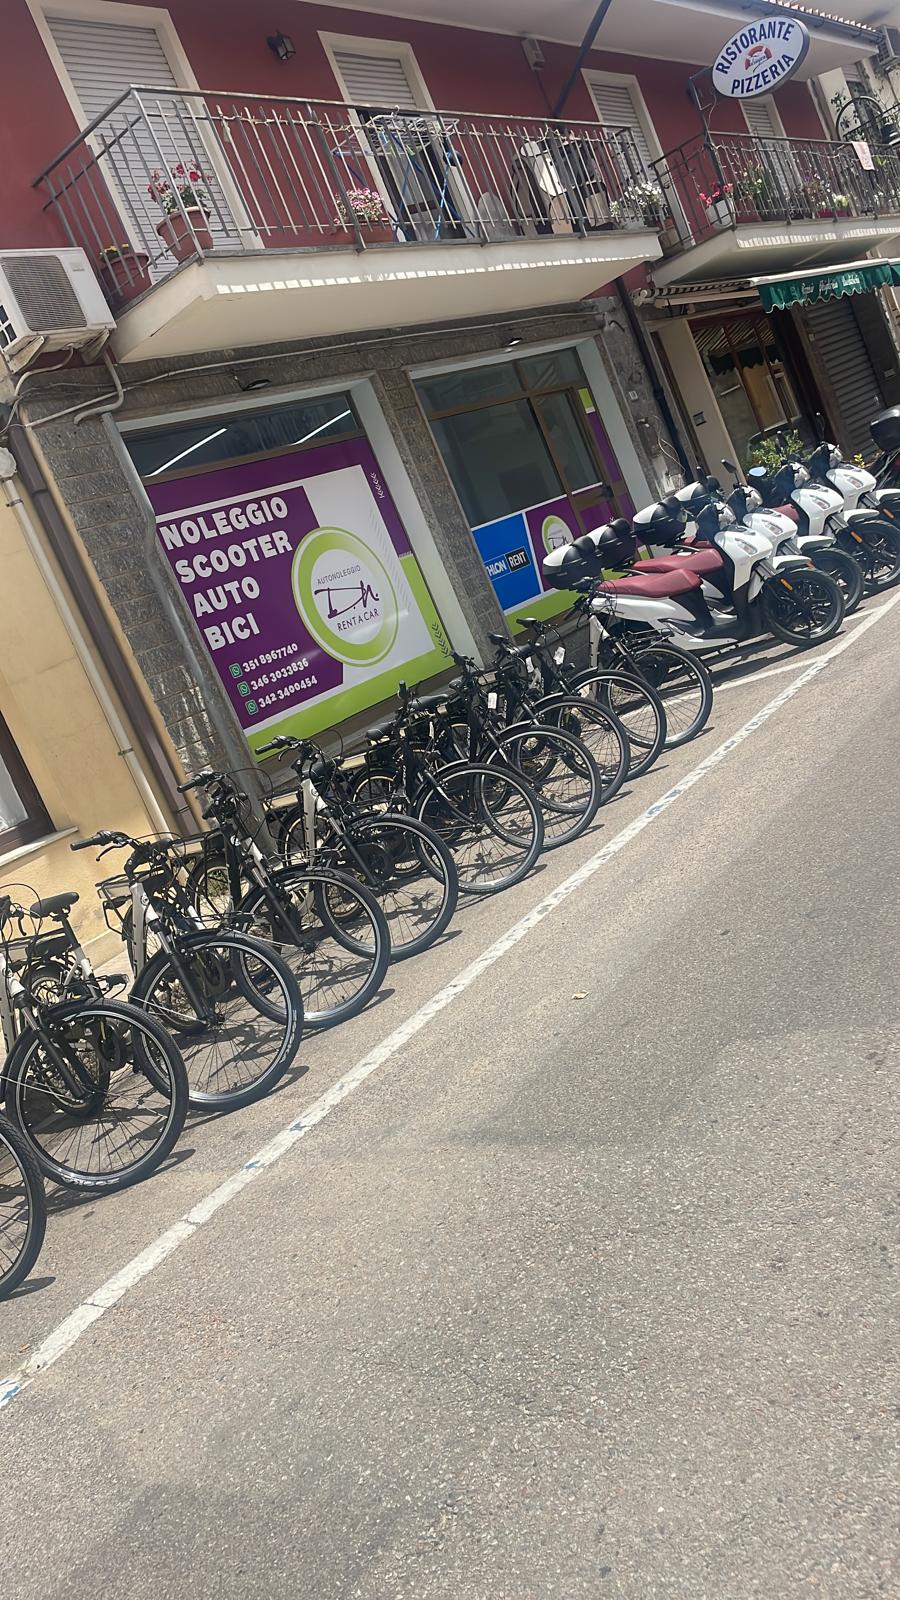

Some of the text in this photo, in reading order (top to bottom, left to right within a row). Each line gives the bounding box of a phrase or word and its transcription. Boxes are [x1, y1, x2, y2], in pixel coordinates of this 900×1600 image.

[715, 21, 795, 75] RISTORANTE
[731, 54, 795, 95] PIZZERIA
[159, 497, 288, 550] NOLEGGIO
[175, 530, 293, 583] SCOOTER
[317, 564, 361, 585] AUTONOLEGGIO
[508, 551, 526, 568] RENT
[193, 576, 260, 617] AUTO
[204, 612, 260, 651] BICI
[337, 608, 380, 632] RENT A CAR
[242, 643, 298, 672] 351 8967740
[250, 657, 309, 690] 346 3033836
[258, 675, 318, 708] 342 3400454
